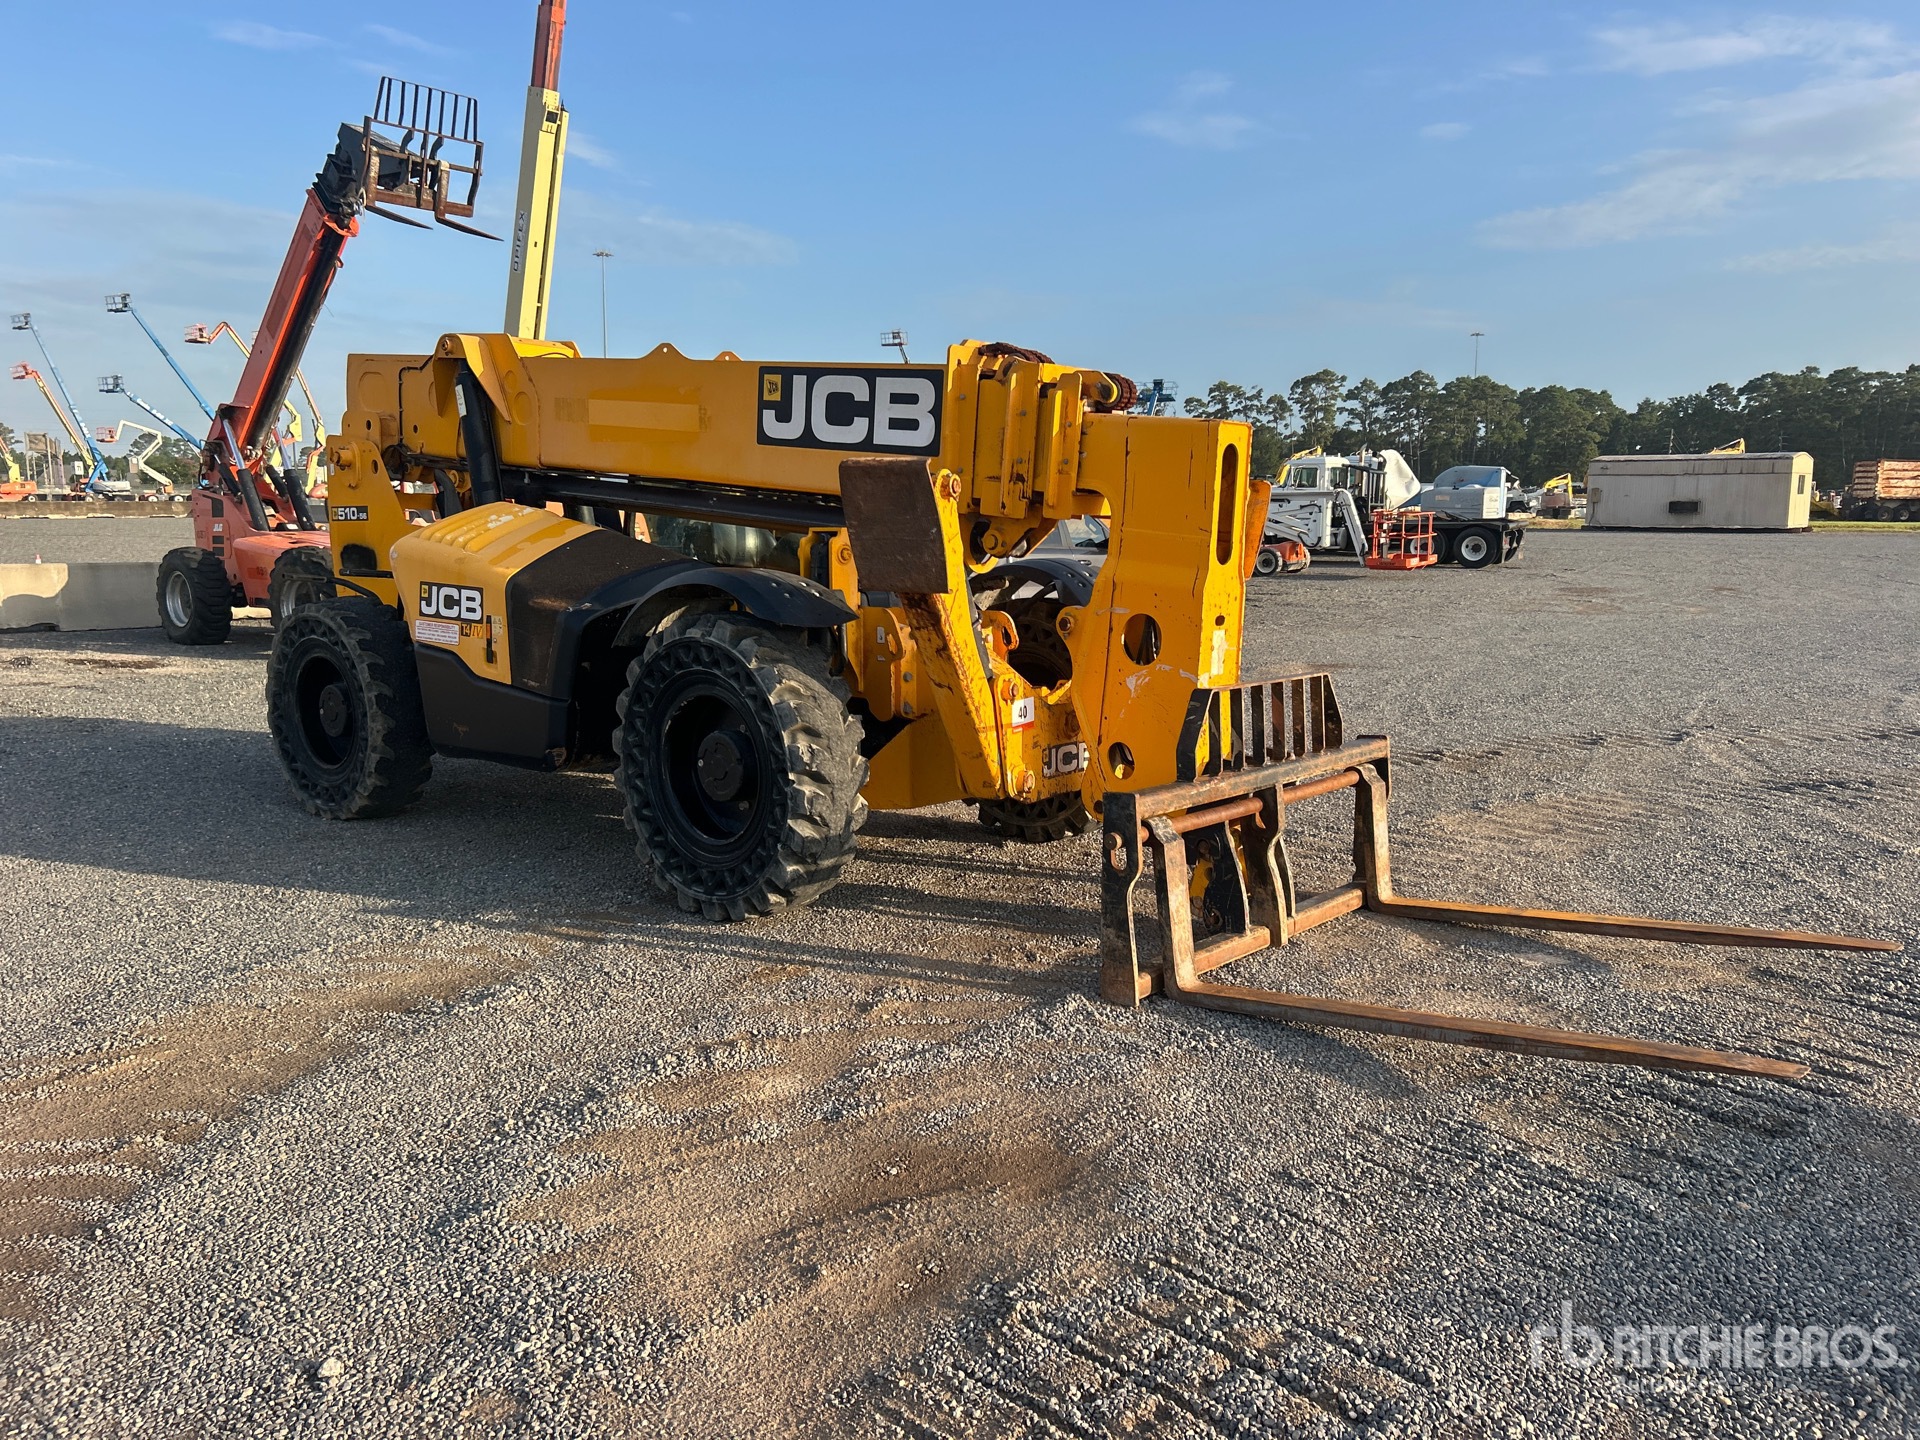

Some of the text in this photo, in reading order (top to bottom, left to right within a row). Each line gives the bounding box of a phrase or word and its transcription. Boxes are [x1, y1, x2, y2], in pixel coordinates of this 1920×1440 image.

[762, 374, 936, 448] JCB
[420, 585, 482, 621] JCB
[1018, 705, 1028, 719] 40
